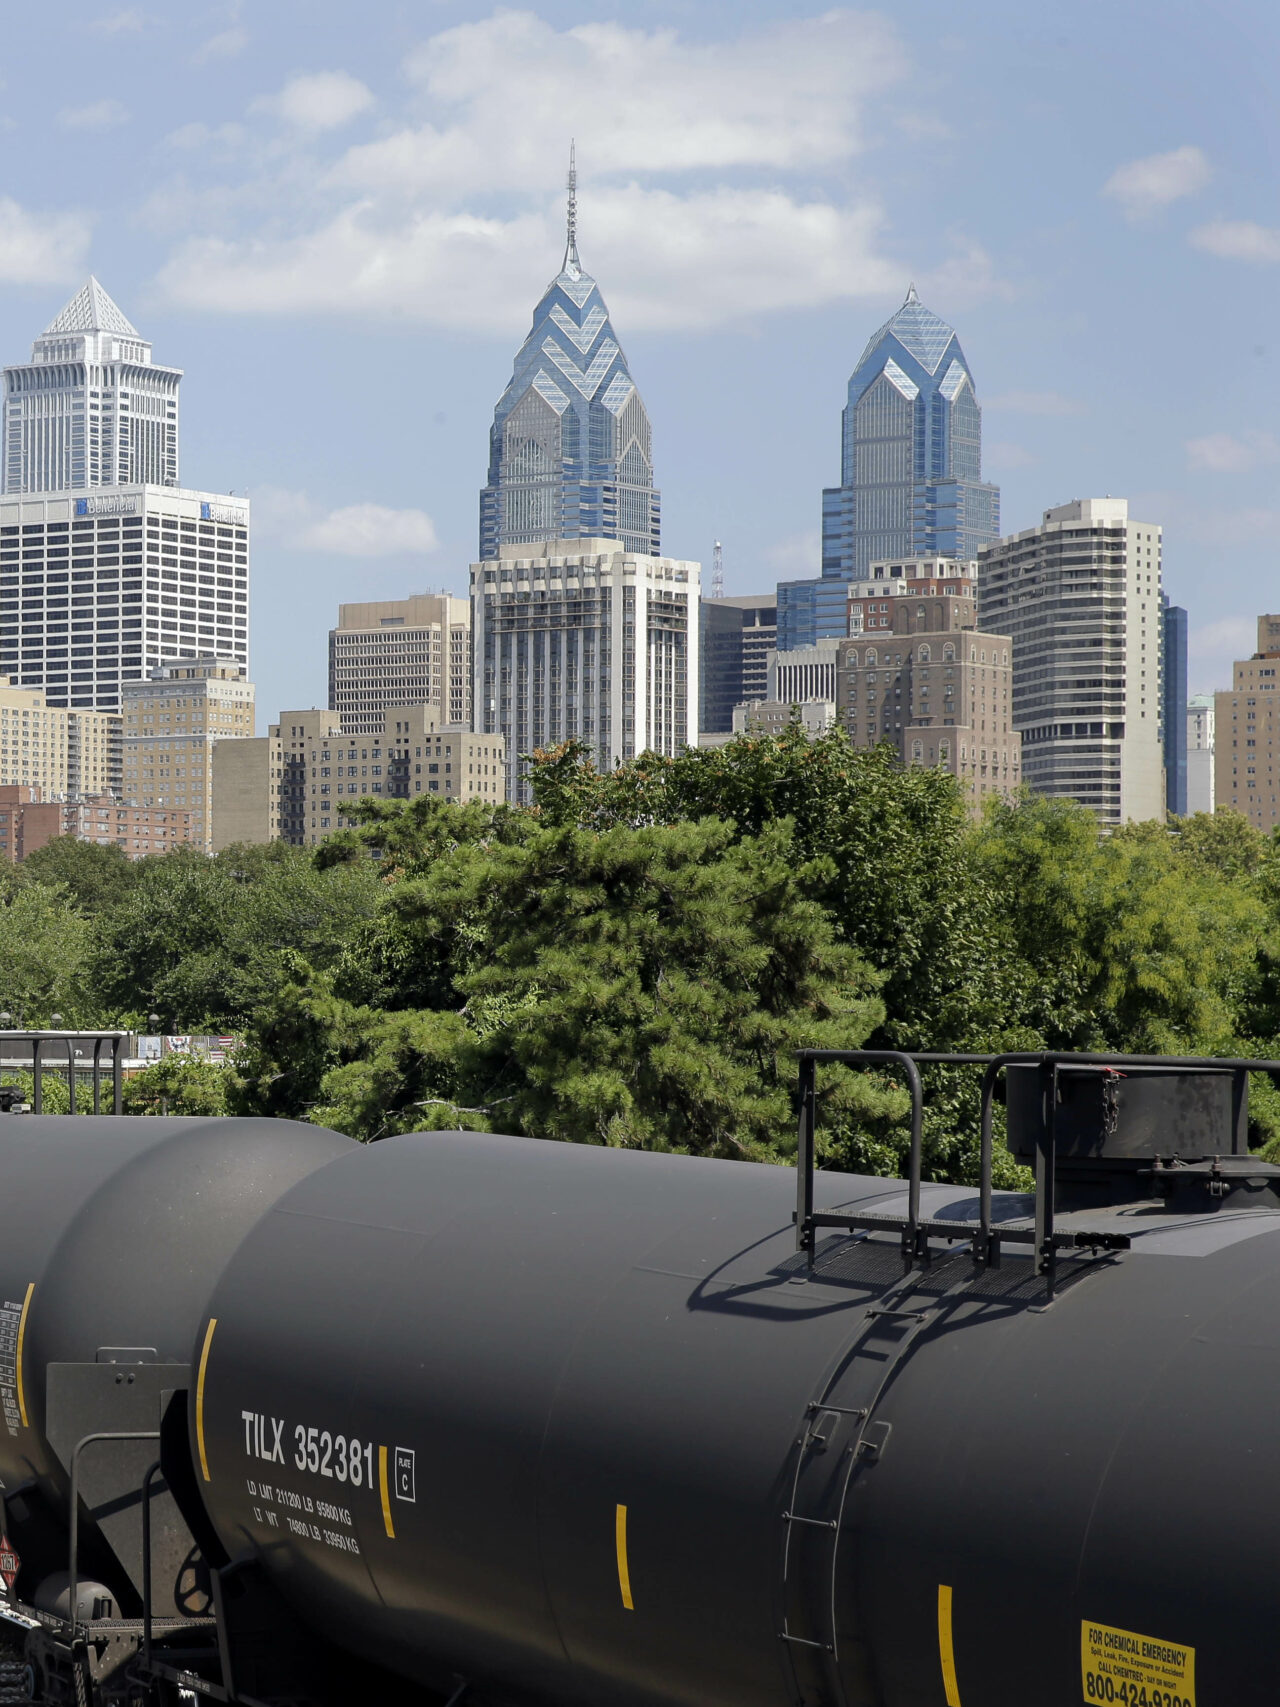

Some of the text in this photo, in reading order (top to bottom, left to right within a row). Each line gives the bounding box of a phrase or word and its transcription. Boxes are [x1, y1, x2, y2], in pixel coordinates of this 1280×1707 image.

[88, 496, 136, 513] Beneficial
[242, 1410, 373, 1489] TILX 352381
[398, 1457, 411, 1469] PLATE
[246, 1480, 257, 1496] LD
[259, 1483, 274, 1501] LMT
[302, 1496, 314, 1513] LB
[402, 1474, 408, 1491] C
[253, 1507, 263, 1523] LT
[265, 1510, 279, 1527] WT
[309, 1524, 322, 1541] LB
[1089, 1628, 1187, 1667] FOR CHEMICAL EMERGENCY
[1098, 1661, 1113, 1675] CALL
[1113, 1664, 1143, 1683] CHEMTREC
[1146, 1675, 1156, 1685] DAY
[1156, 1678, 1163, 1687] OR
[1163, 1680, 1176, 1690] NIGHT
[1130, 1657, 1154, 1670] Exposure
[1155, 1663, 1161, 1672] or
[1161, 1665, 1184, 1679] Accident
